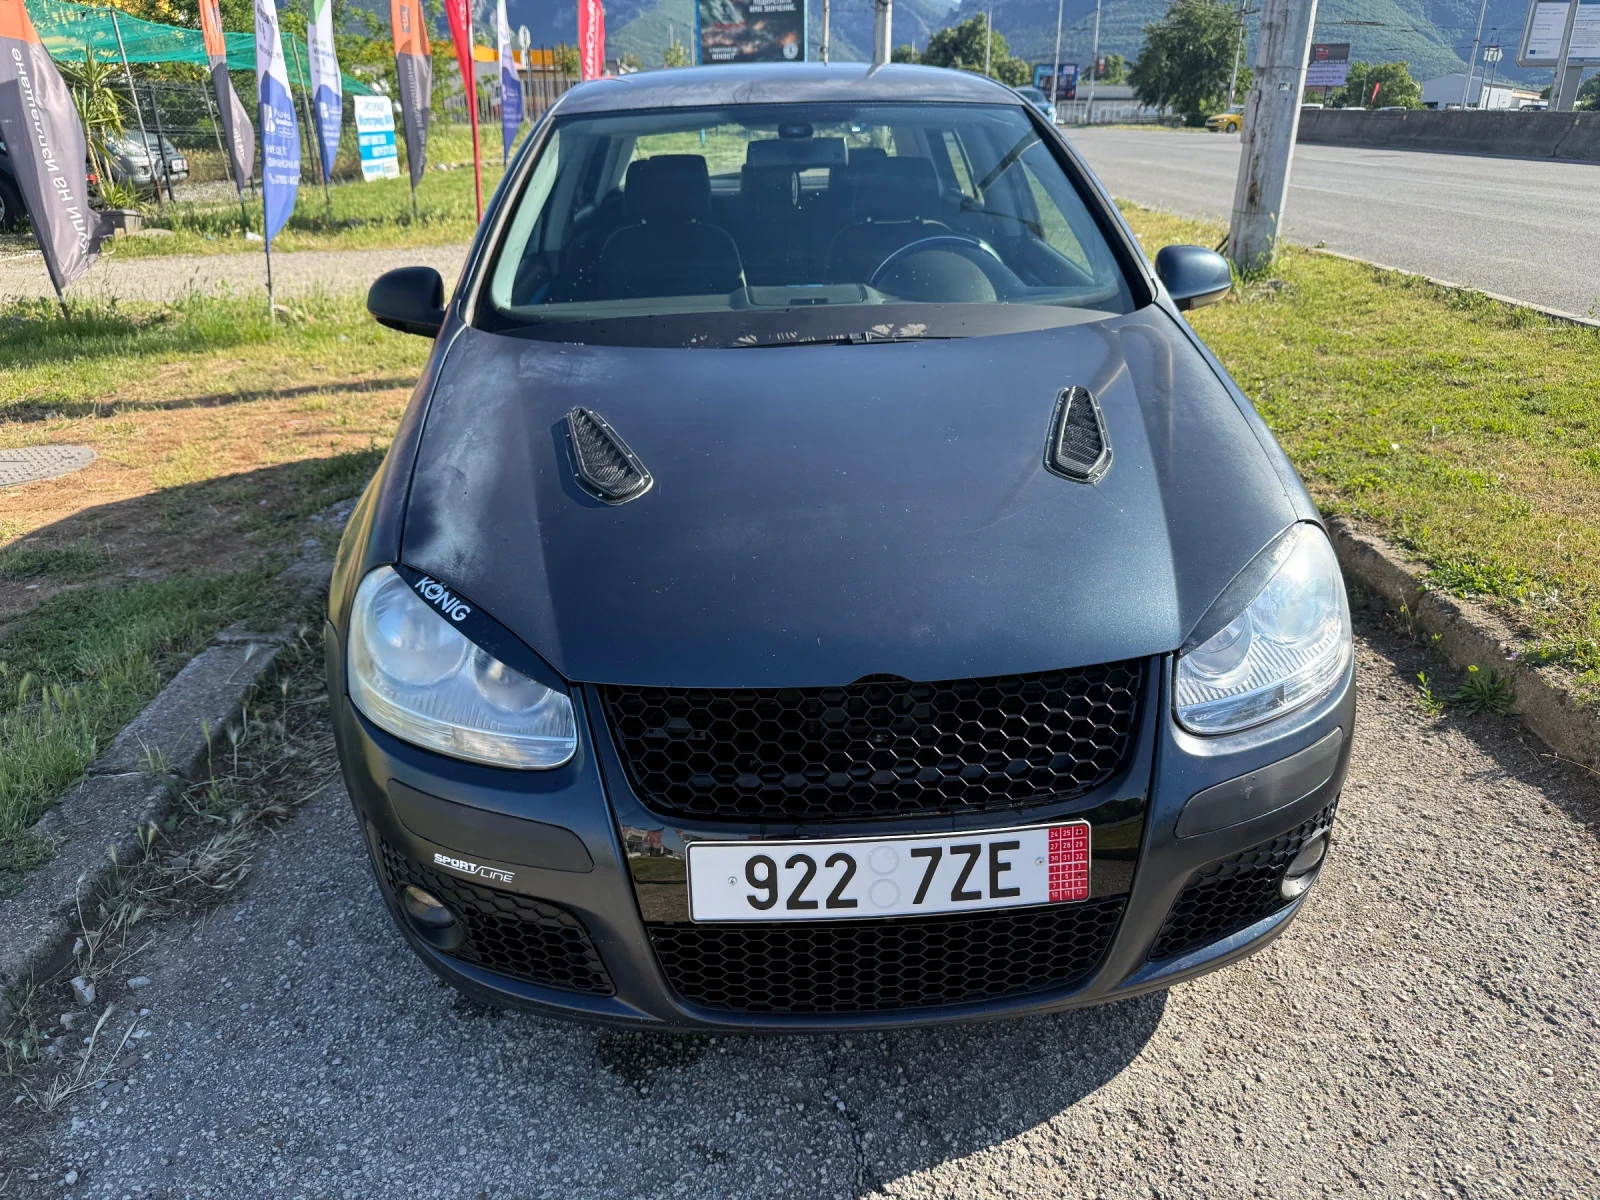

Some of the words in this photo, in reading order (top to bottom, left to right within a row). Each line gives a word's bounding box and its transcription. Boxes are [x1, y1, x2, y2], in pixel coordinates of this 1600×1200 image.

[11, 47, 58, 172] изплащане
[52, 177, 74, 202] на
[433, 852, 477, 872] SPORT
[744, 852, 858, 911] 922
[910, 840, 1021, 904] 7ZE
